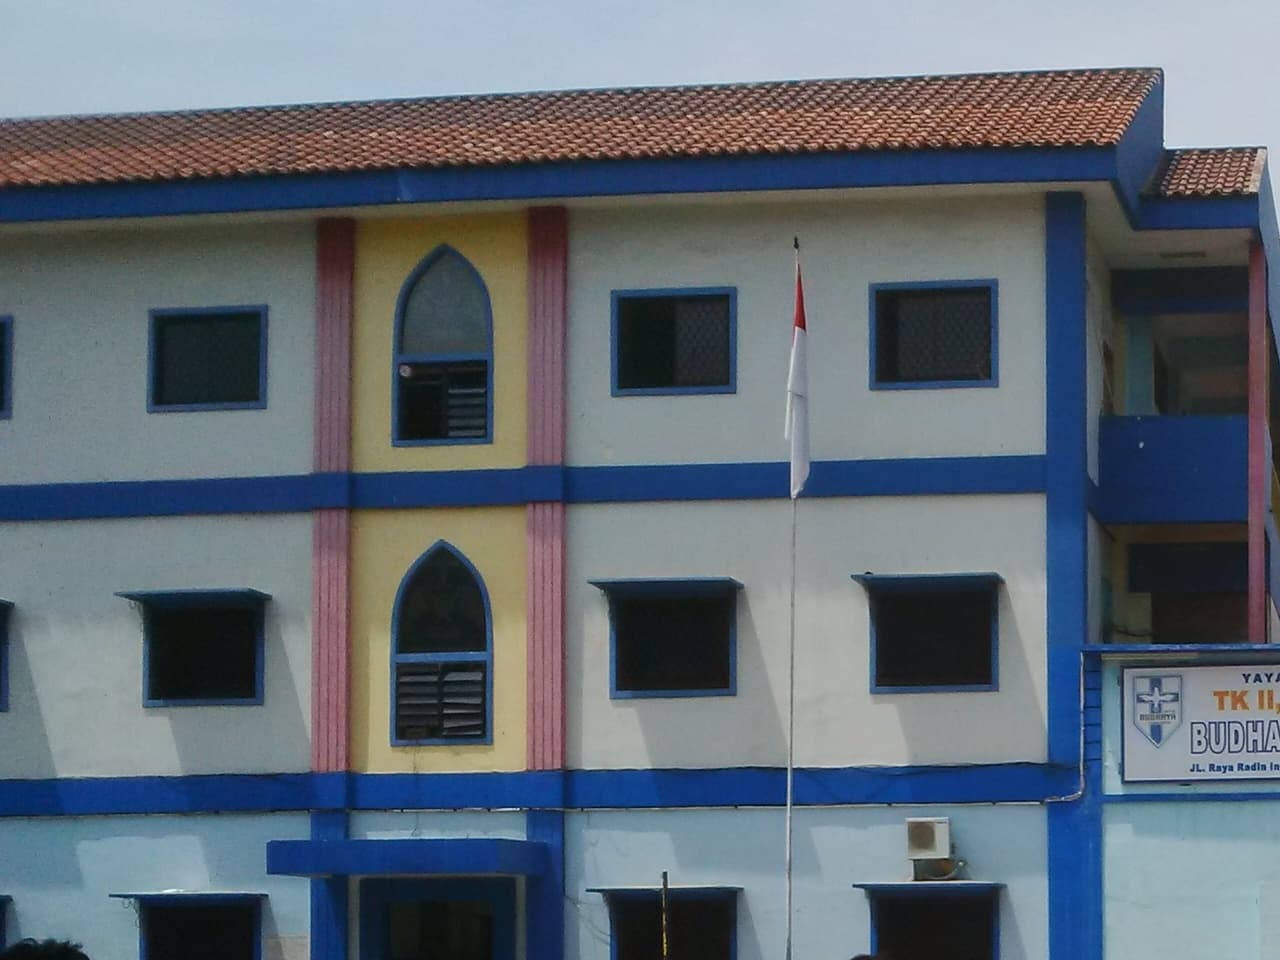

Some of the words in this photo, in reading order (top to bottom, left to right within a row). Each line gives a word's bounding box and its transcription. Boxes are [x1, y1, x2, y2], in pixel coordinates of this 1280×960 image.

[1213, 690, 1250, 711] TK
[1208, 763, 1235, 775] Raya
[1237, 762, 1267, 772] Radin
